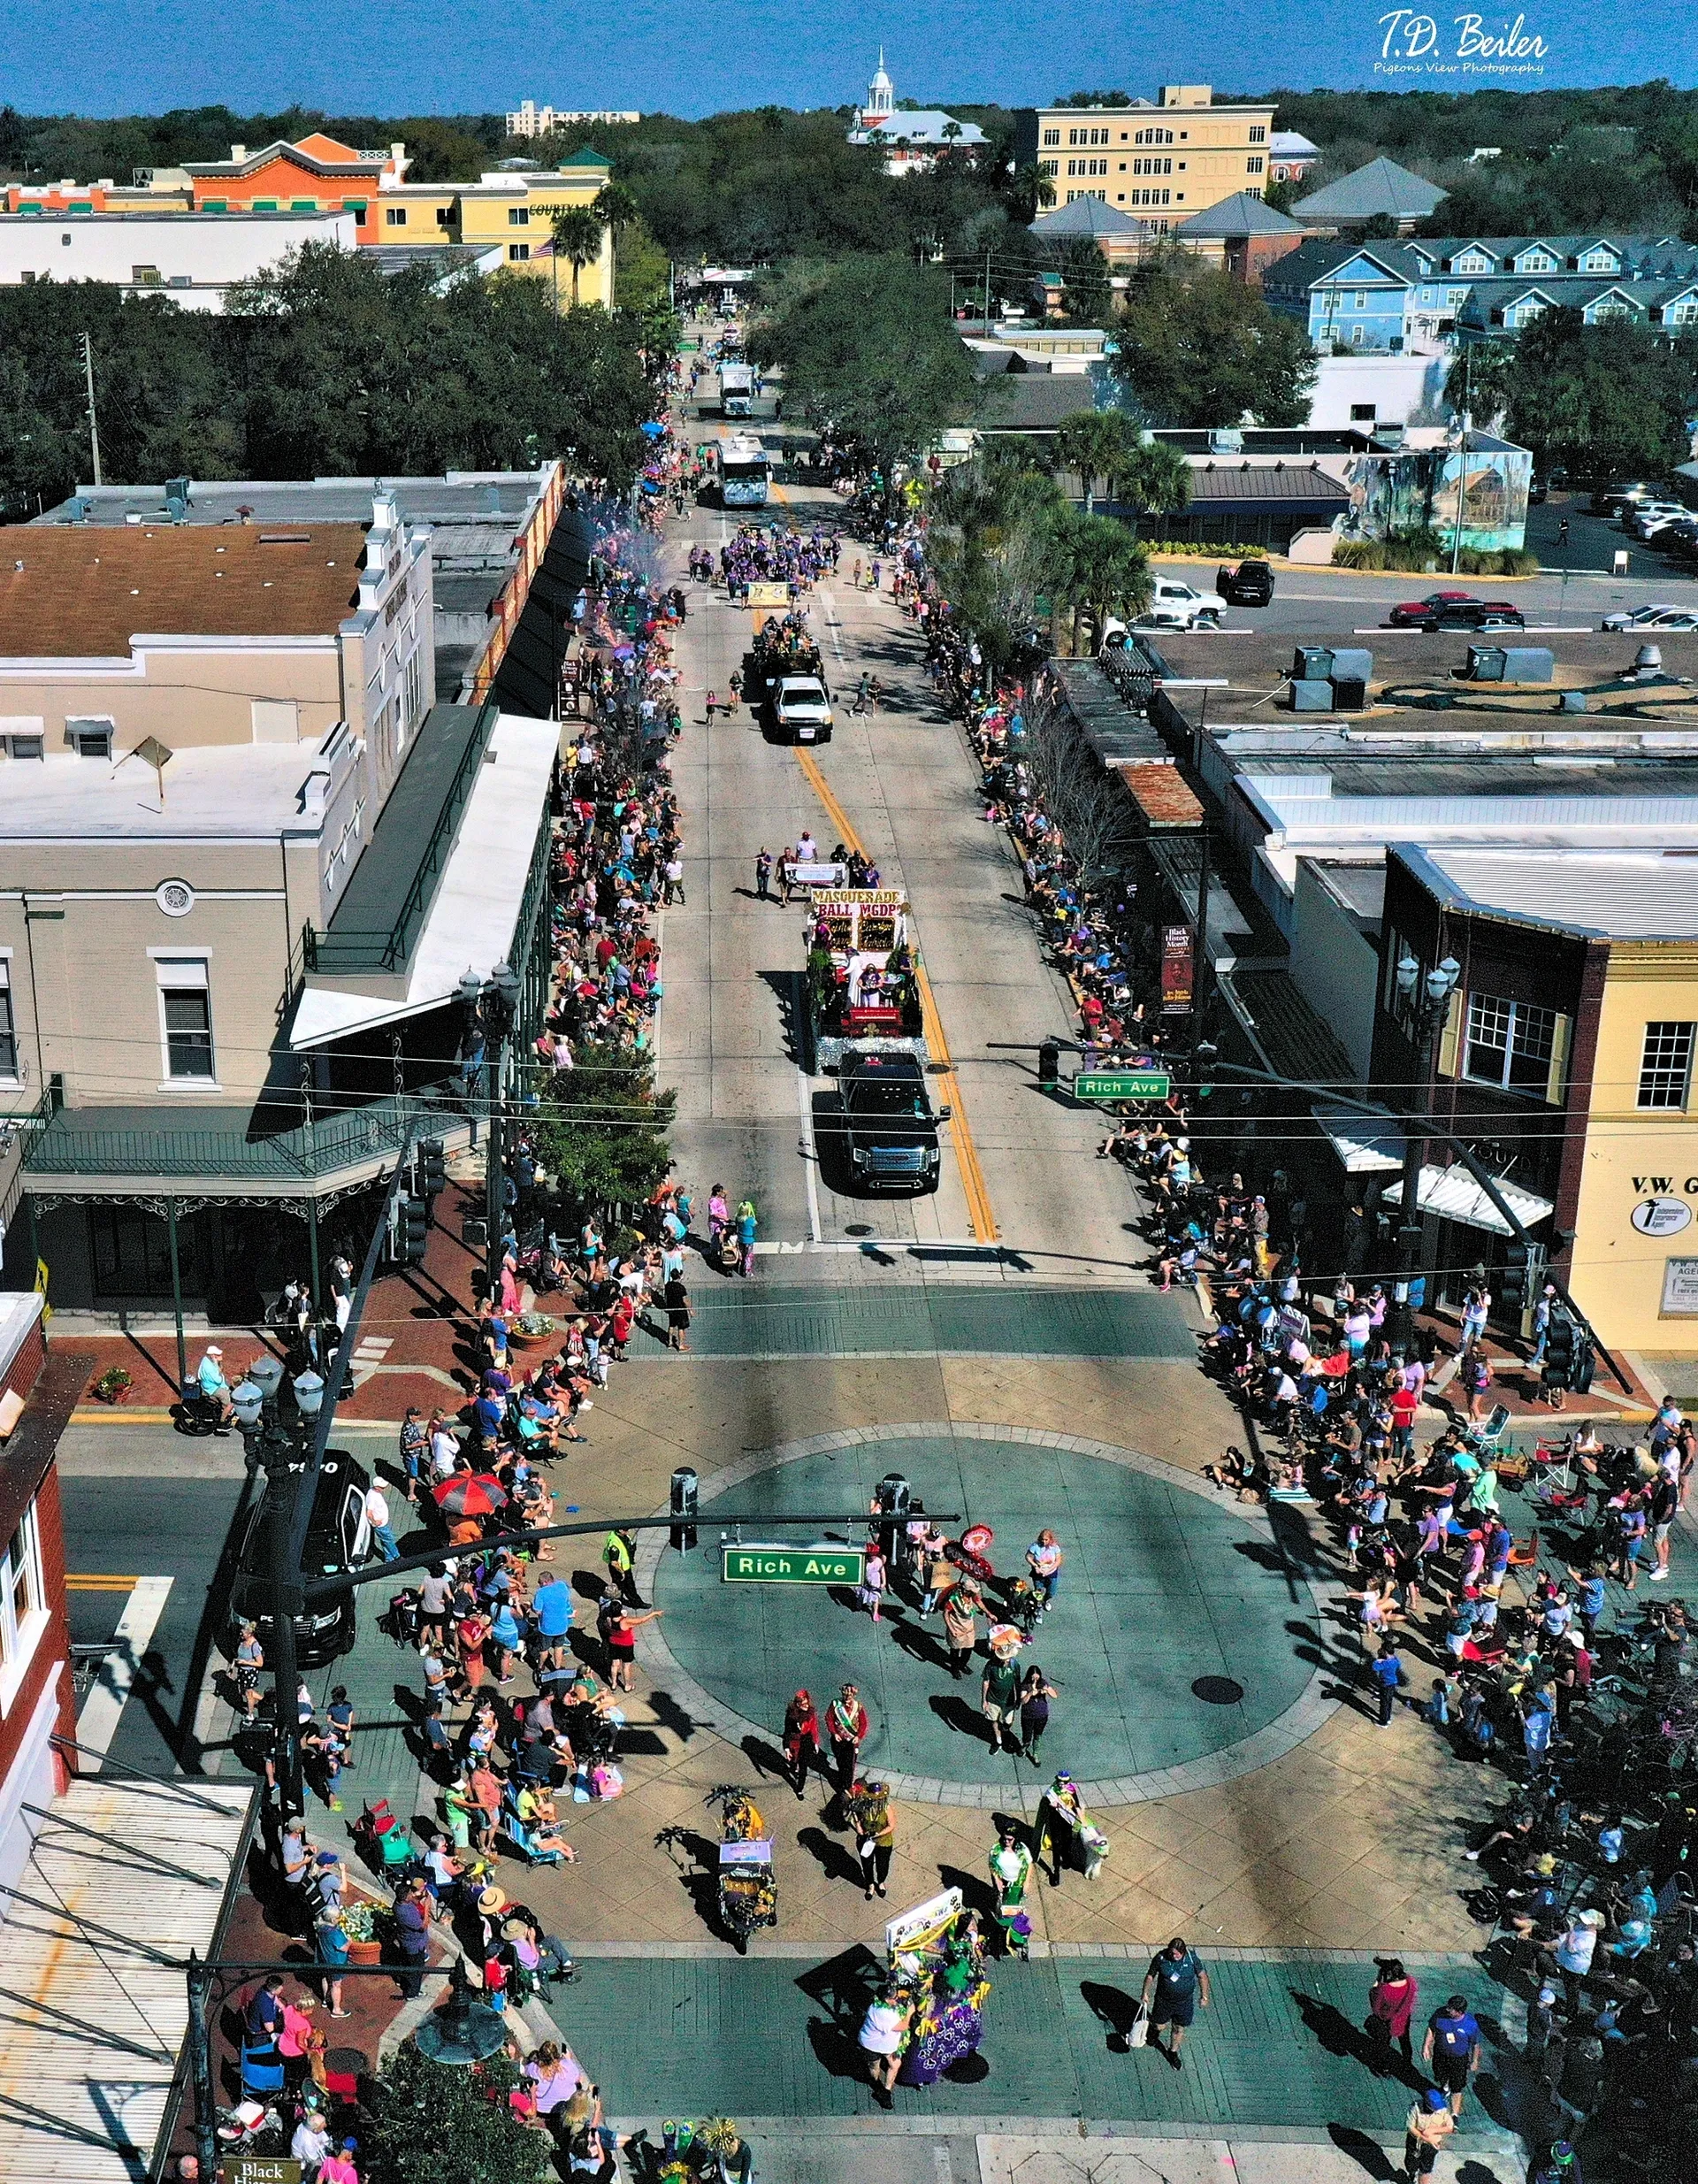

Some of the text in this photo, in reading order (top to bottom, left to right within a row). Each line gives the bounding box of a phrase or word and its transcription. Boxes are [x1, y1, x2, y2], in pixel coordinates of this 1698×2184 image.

[813, 891, 900, 902] MASQUERADE
[819, 903, 852, 916] BALL
[1165, 934, 1190, 944] History
[1085, 1081, 1159, 1093] Rich Ave
[739, 1558, 846, 1575] Rich Ave
[241, 2163, 283, 2179] Black
